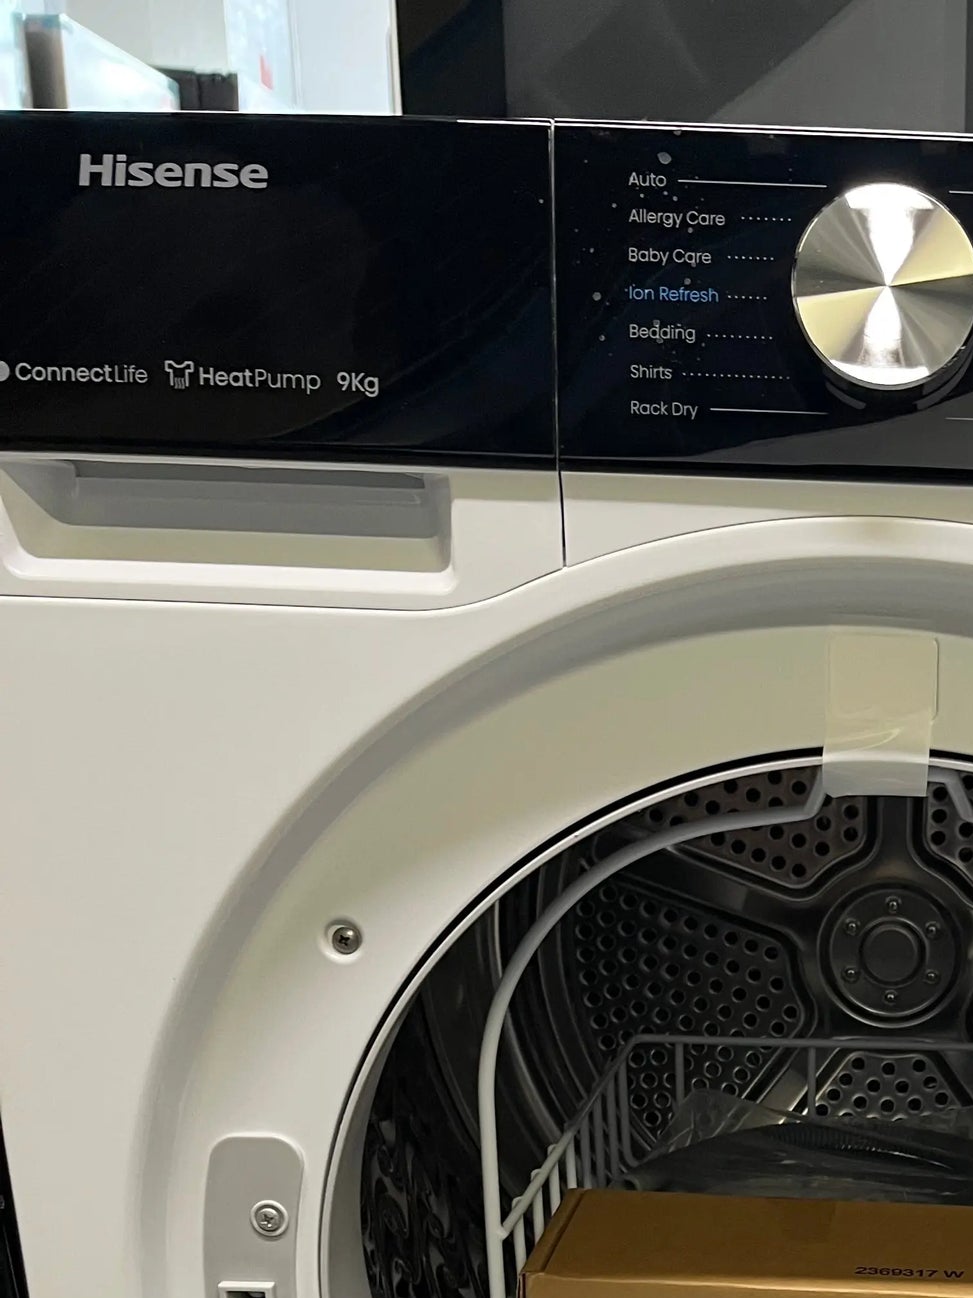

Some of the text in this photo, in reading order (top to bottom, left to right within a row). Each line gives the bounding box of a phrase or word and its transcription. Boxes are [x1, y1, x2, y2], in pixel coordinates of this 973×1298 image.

[77, 153, 269, 189] Hisense
[628, 171, 667, 187] Auto
[628, 208, 726, 228] Allergy Care
[628, 247, 712, 265] Baby Care
[628, 286, 719, 302] Ion Refresh
[629, 323, 696, 344] Bedding
[15, 361, 379, 399] ConnectLife HeatPump 9Kg
[630, 365, 672, 380] Shirts
[630, 400, 698, 420] Rack Dry
[854, 1266, 965, 1279] 2369317 W
